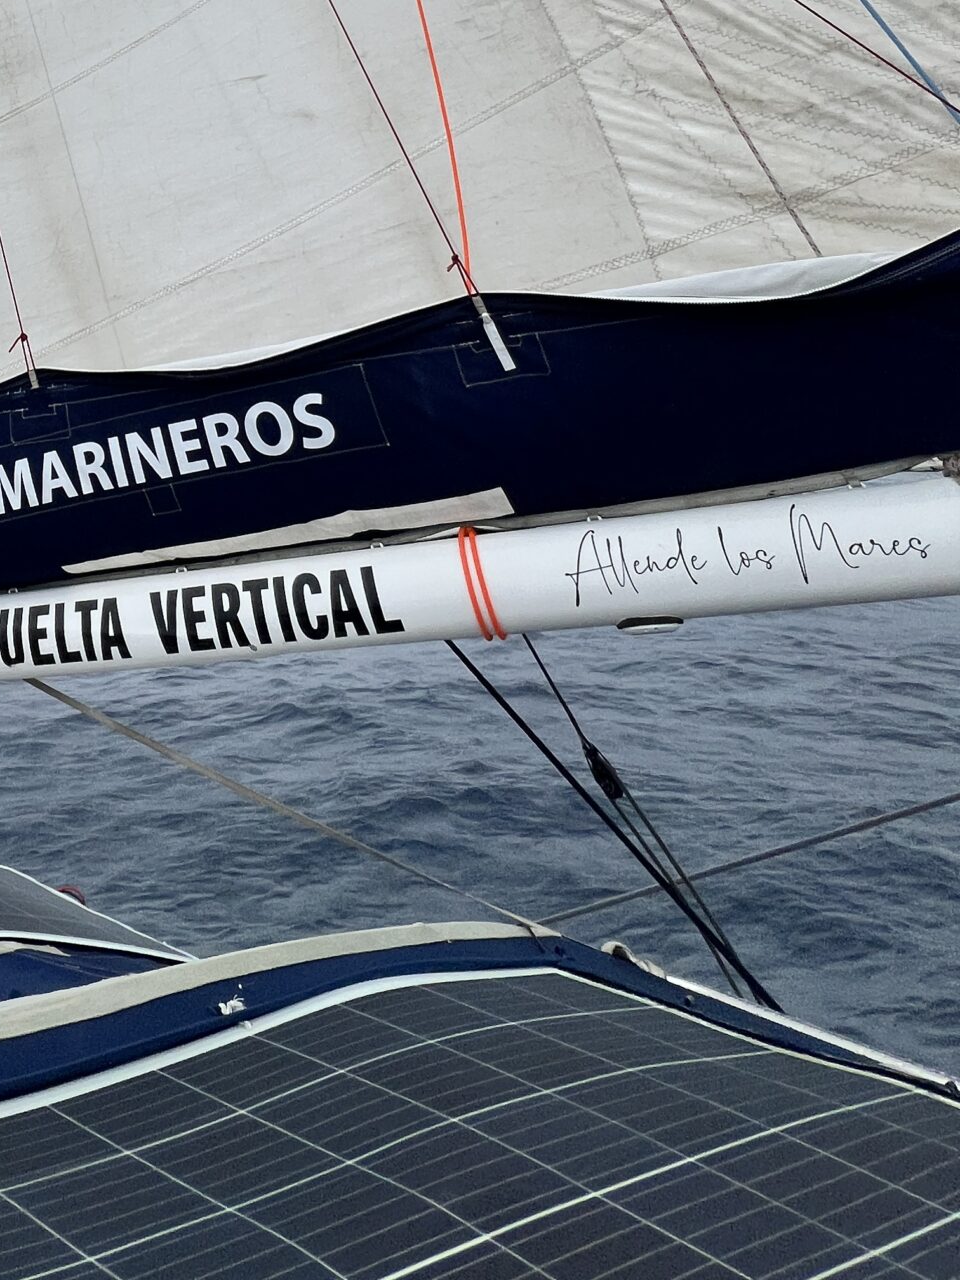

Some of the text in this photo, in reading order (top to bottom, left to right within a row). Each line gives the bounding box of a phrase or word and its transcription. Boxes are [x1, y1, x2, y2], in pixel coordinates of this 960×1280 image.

[566, 504, 931, 607] Allende los Mares
[149, 565, 405, 656] VERTICAL
